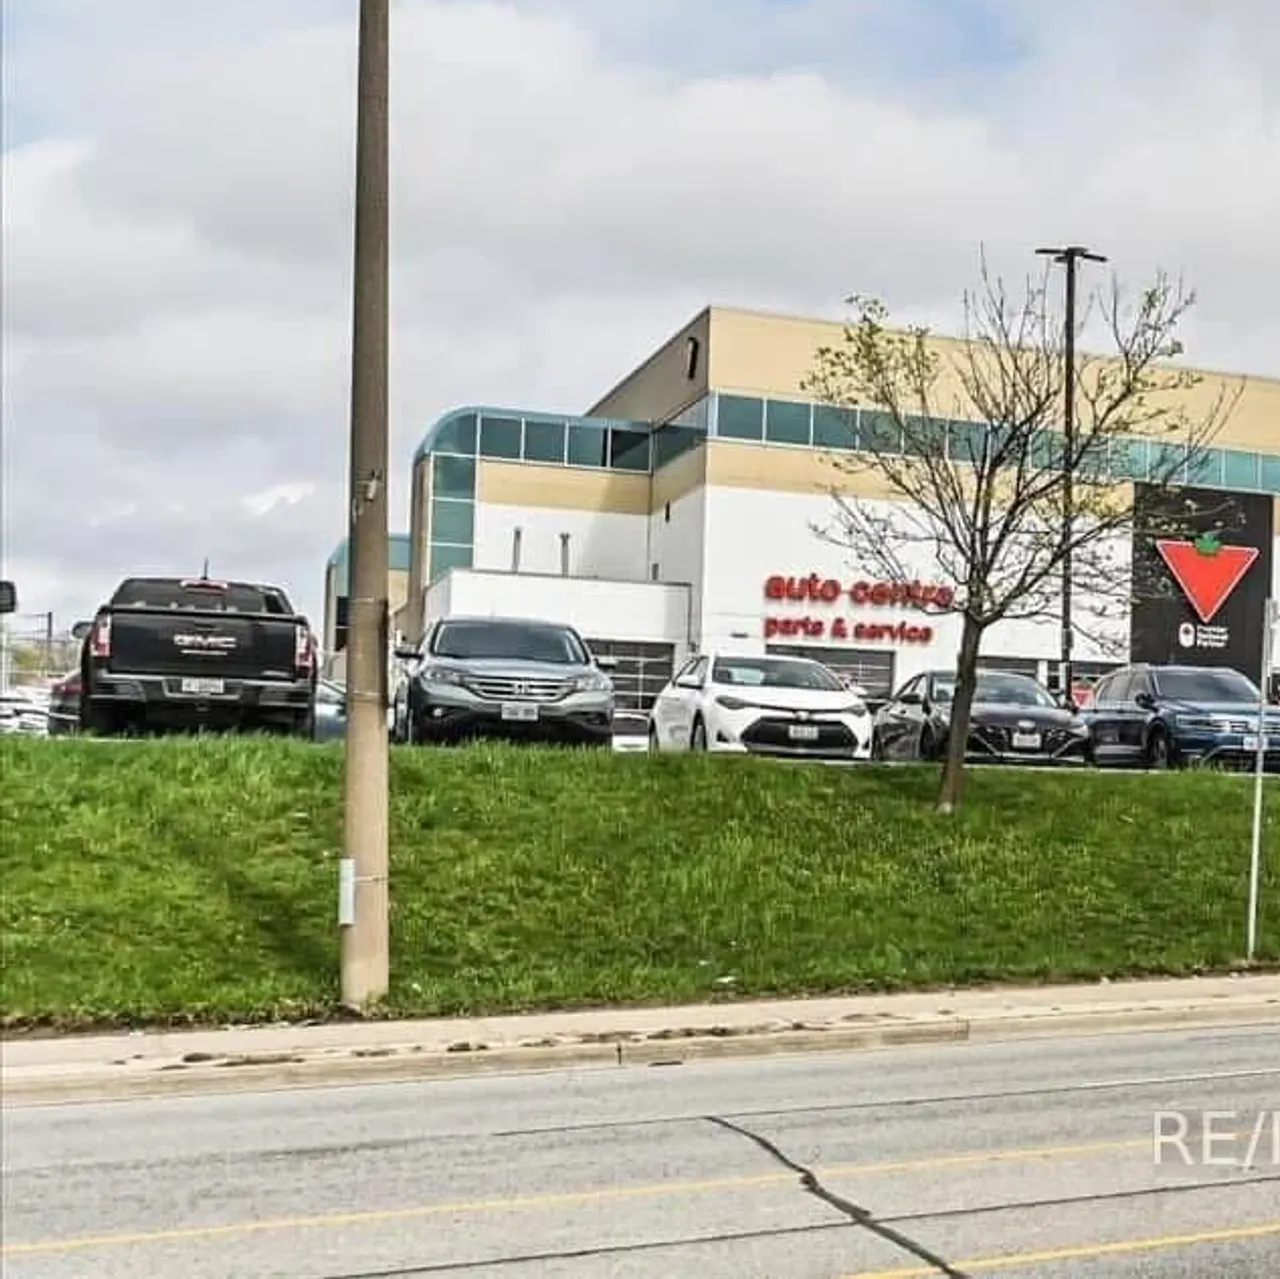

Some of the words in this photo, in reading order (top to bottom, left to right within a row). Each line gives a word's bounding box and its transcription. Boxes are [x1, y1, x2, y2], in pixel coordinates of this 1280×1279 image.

[764, 573, 841, 602] auto
[764, 616, 824, 639] parts
[831, 618, 847, 639] &
[854, 621, 932, 645] service
